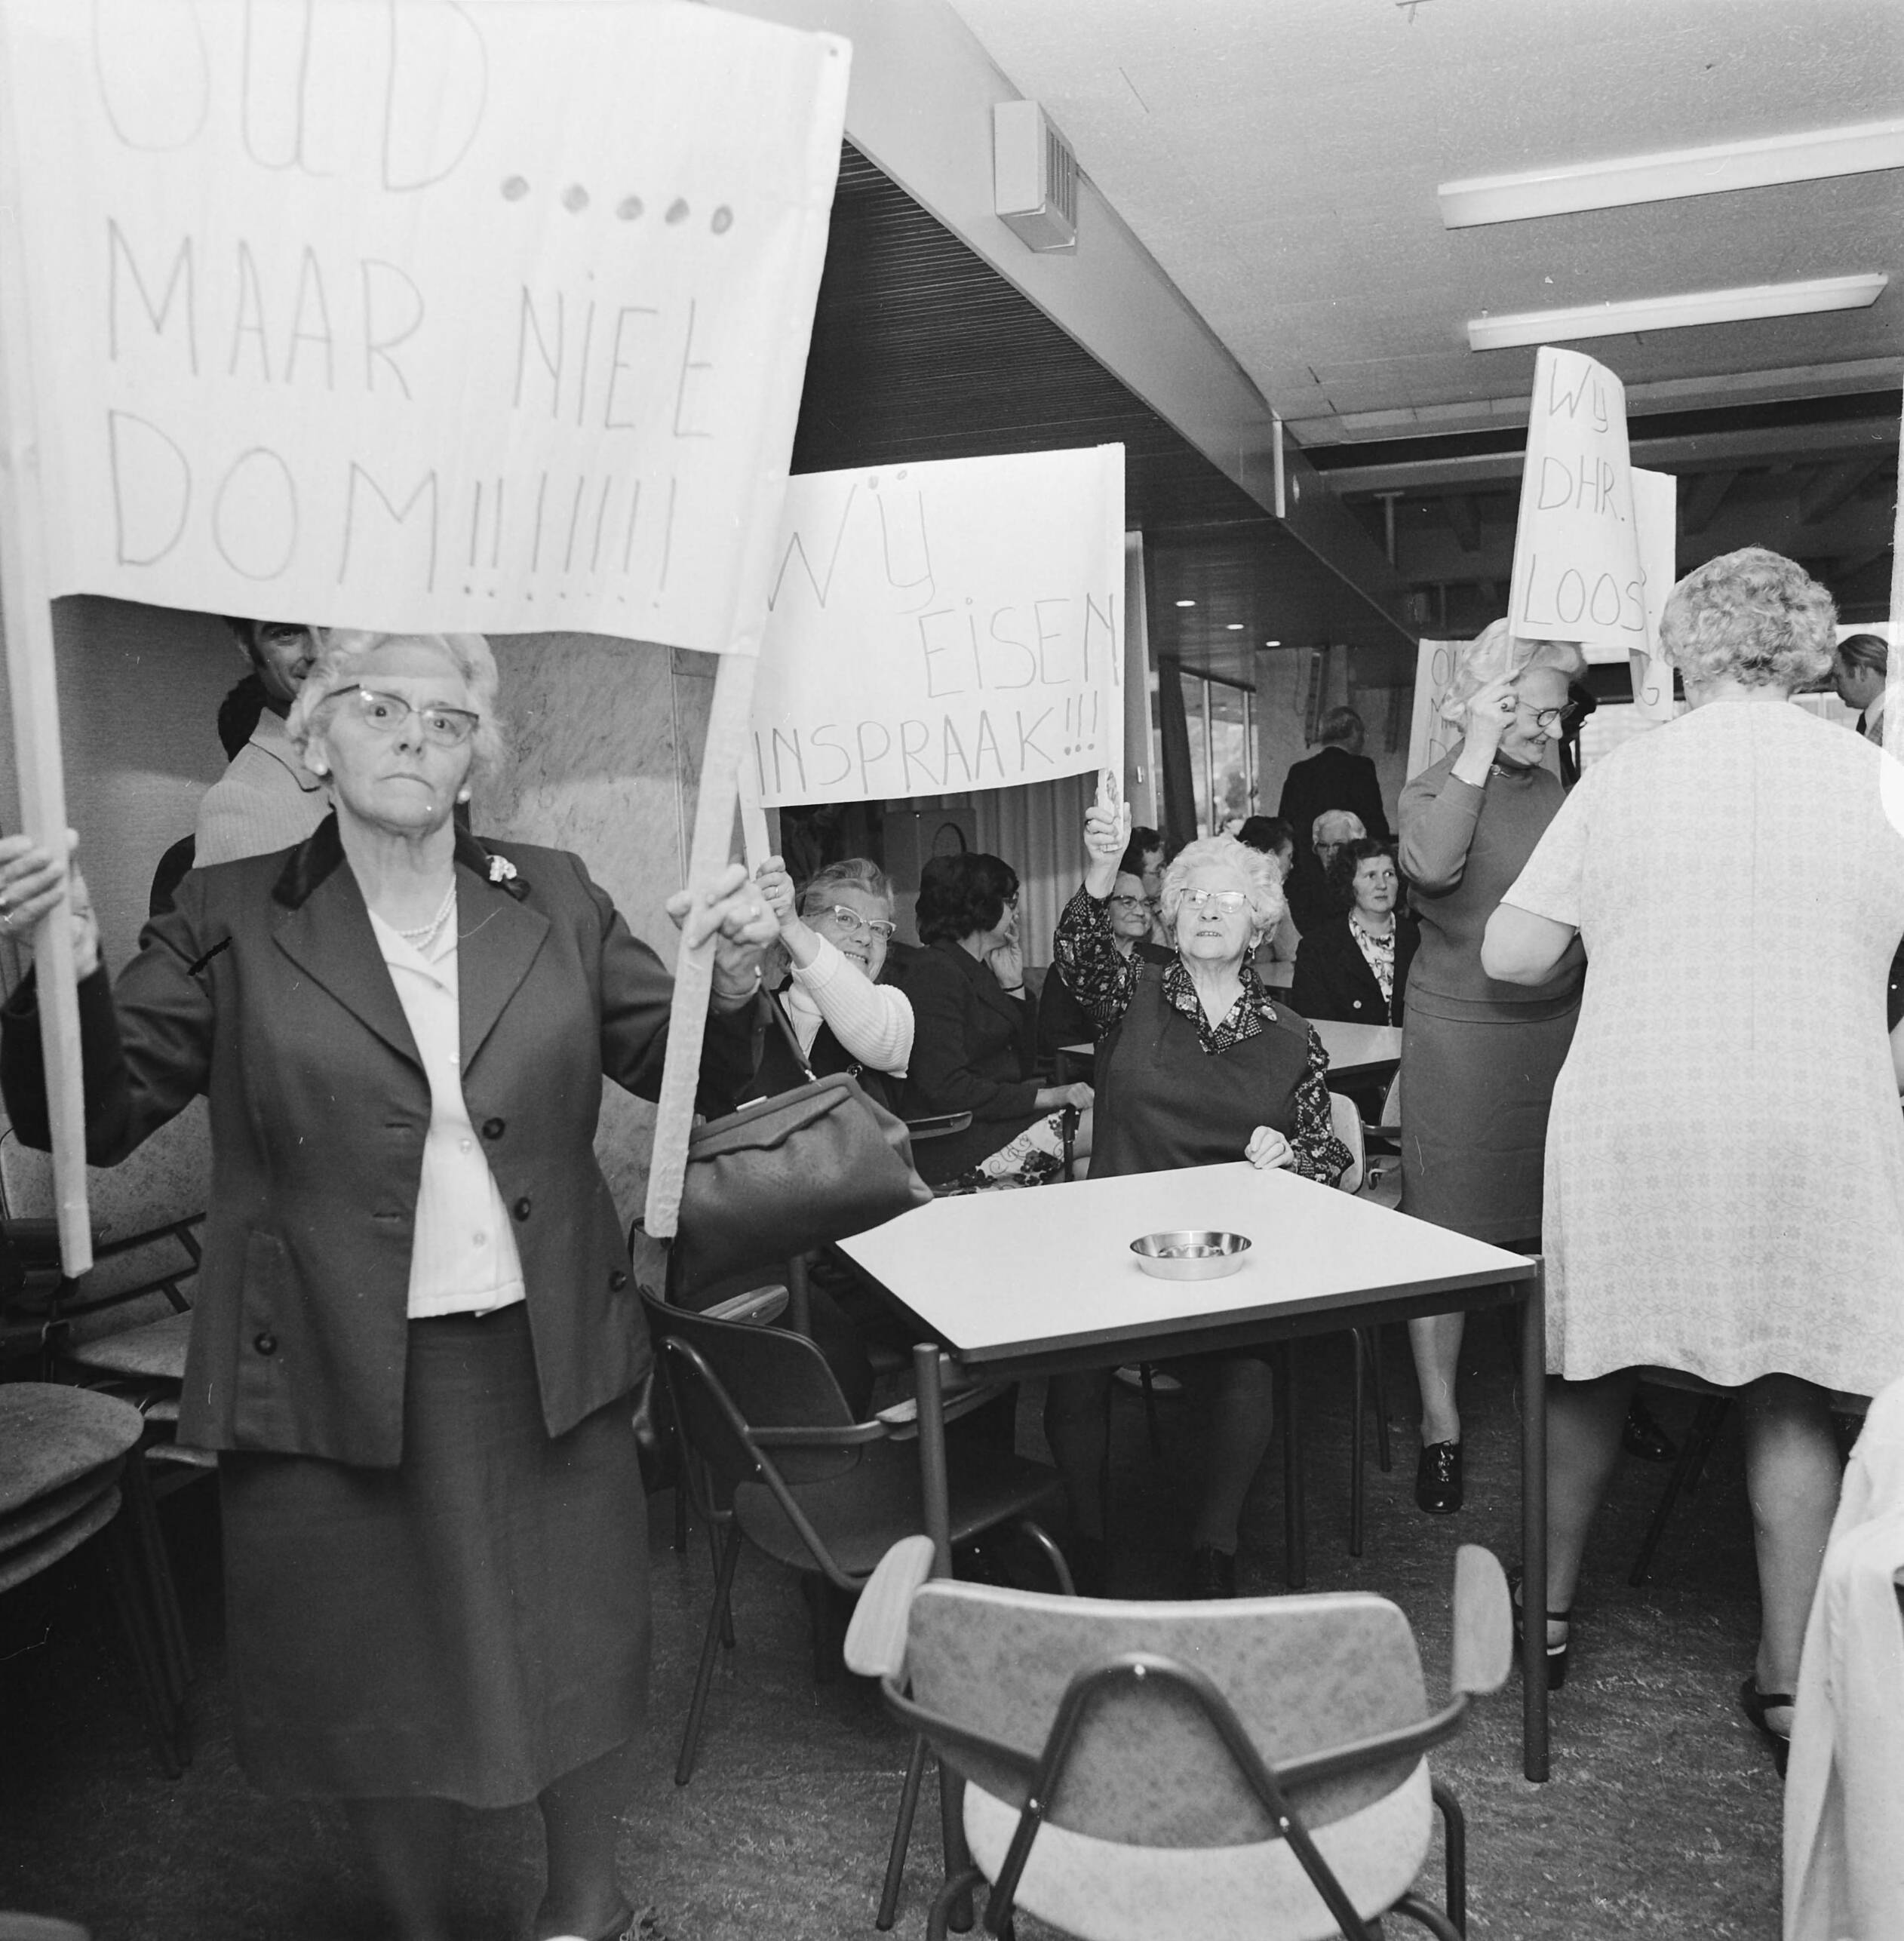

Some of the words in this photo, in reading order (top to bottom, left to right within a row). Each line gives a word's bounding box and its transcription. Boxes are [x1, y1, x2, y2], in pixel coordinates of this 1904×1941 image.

[106, 215, 426, 402] MAAR
[1537, 454, 1626, 521] DHR.
[917, 591, 1119, 699] EISEN
[1523, 553, 1645, 632] LOOS
[754, 689, 1099, 797] INSPRAAK!!!
